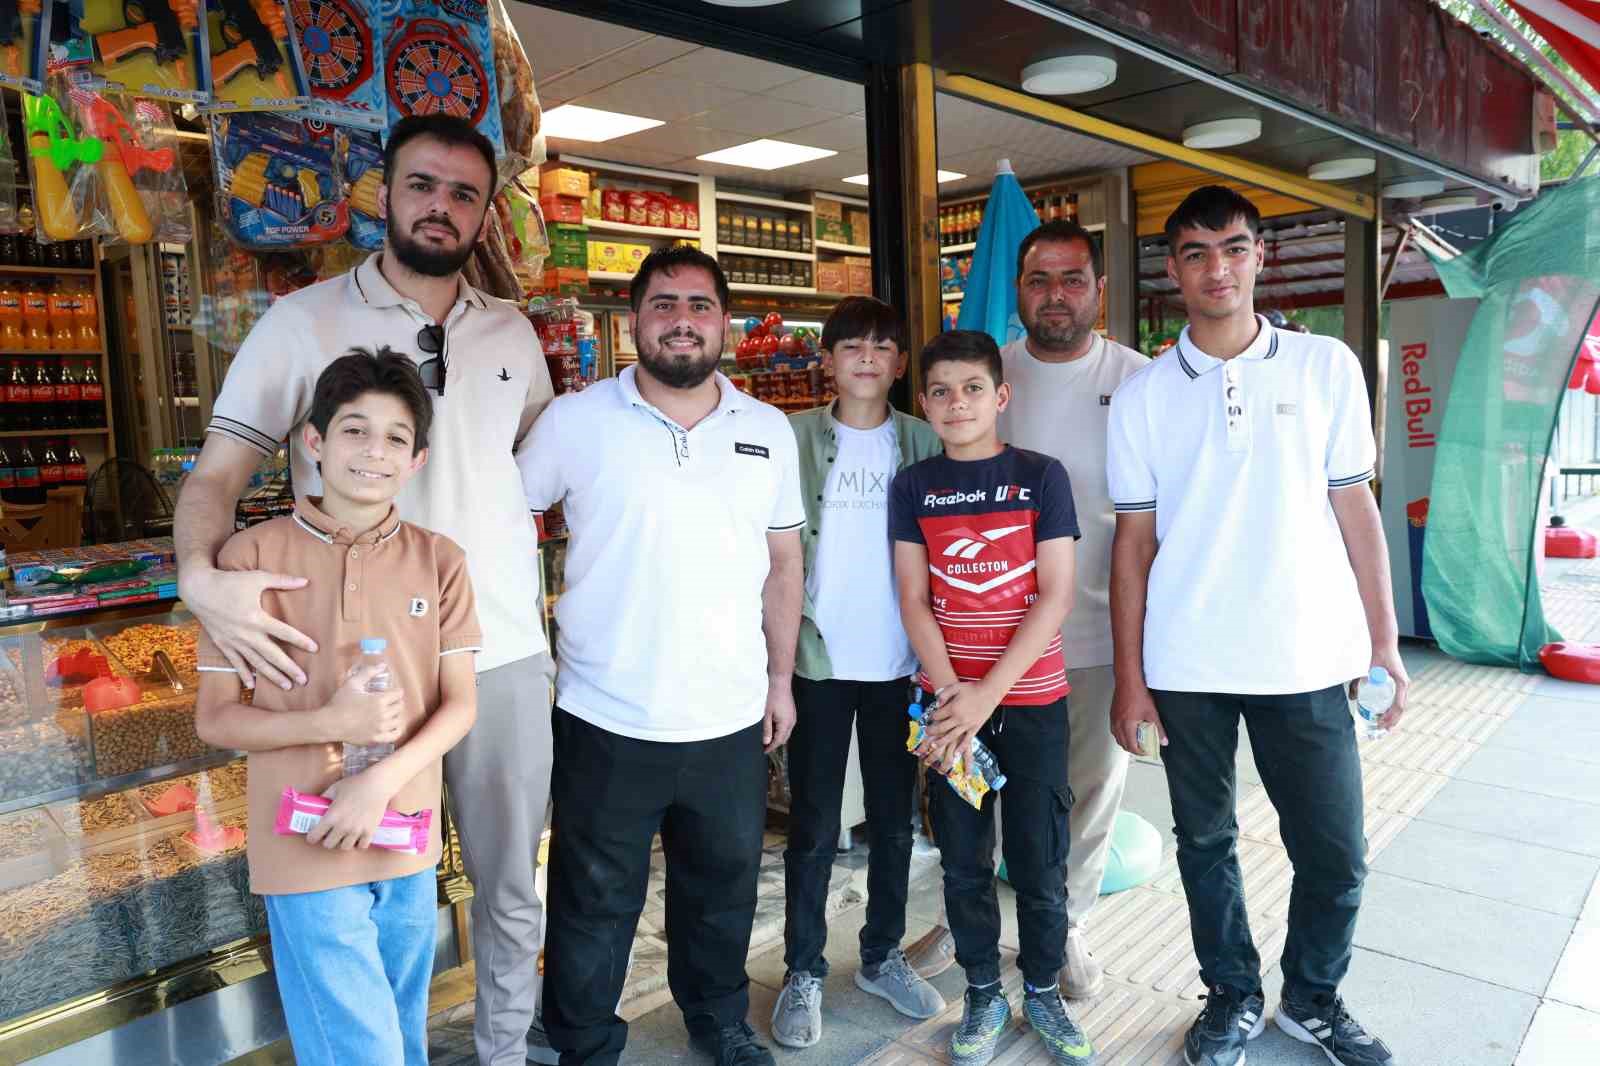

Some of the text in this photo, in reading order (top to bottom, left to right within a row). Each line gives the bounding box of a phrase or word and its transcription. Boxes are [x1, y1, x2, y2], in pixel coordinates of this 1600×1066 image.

[282, 225, 310, 233] POWER
[1401, 342, 1437, 448] Red Bull
[924, 489, 987, 509] Reebok
[995, 484, 1031, 502] UFC
[947, 560, 1008, 575] COLLECTON
